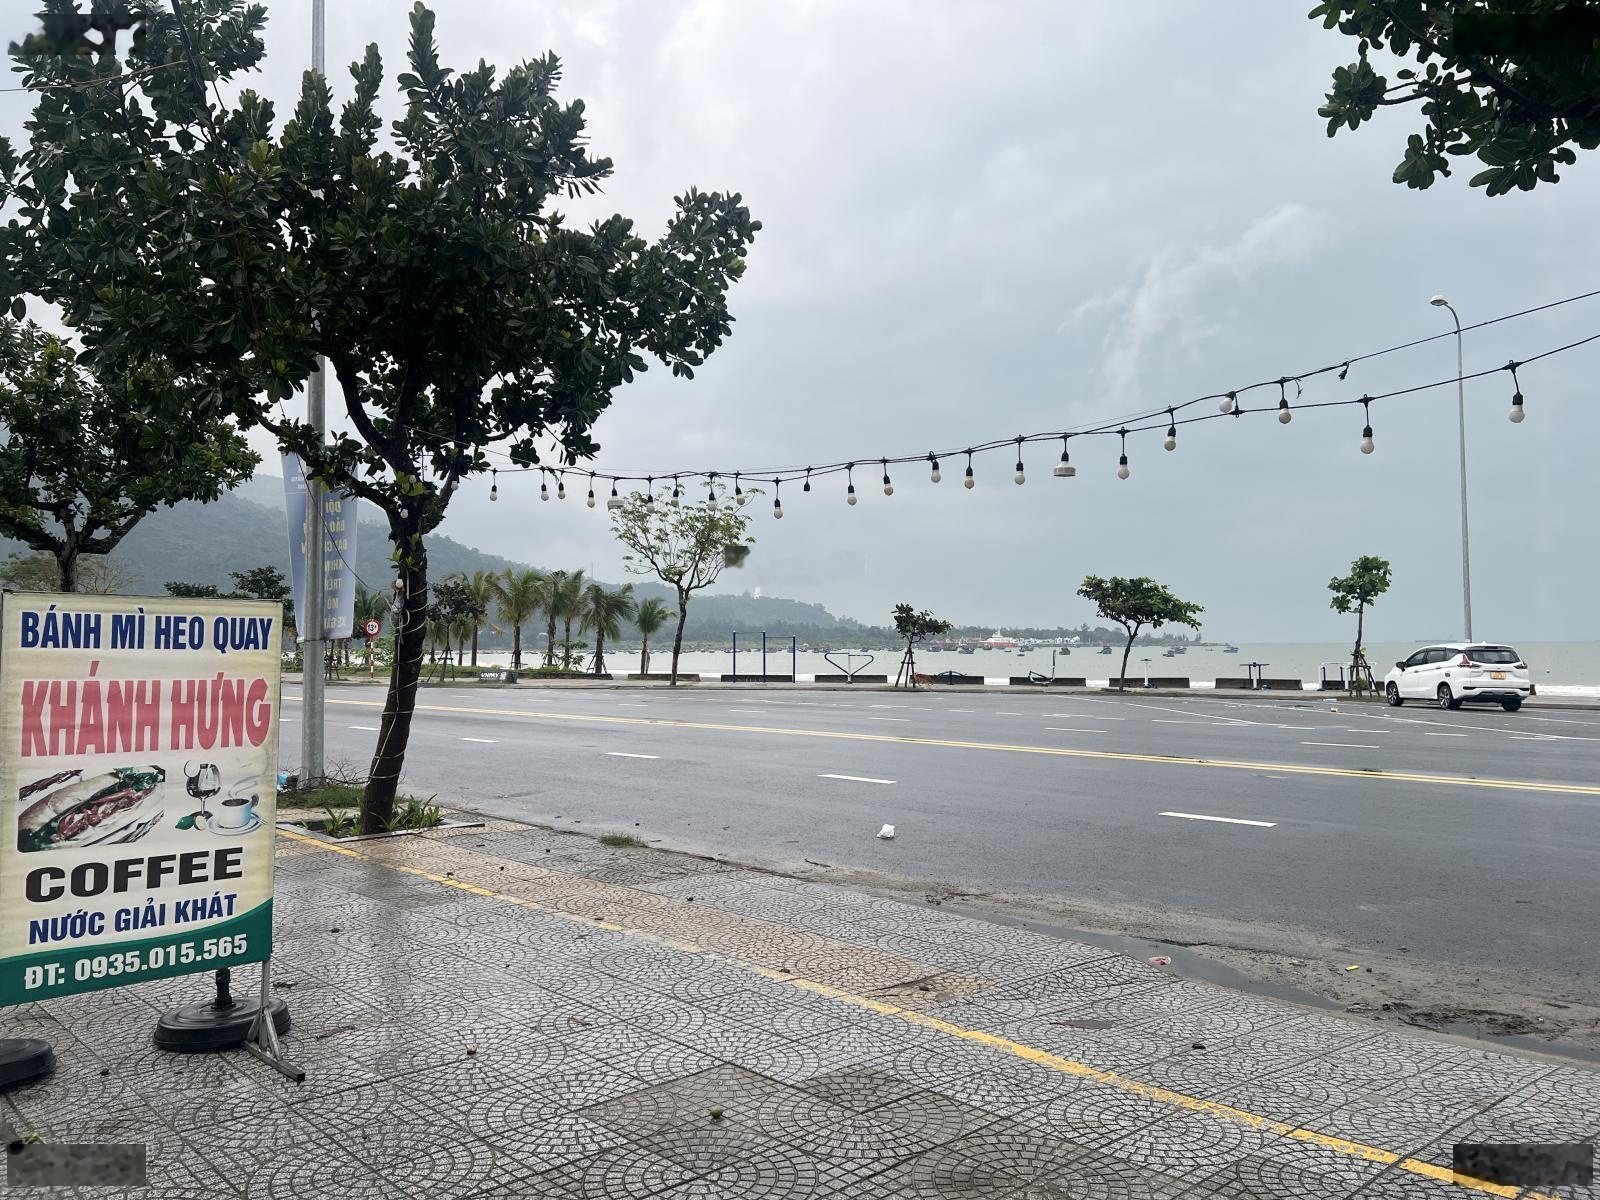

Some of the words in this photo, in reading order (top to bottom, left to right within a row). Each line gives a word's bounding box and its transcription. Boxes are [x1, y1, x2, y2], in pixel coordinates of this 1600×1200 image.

[21, 605, 101, 649] BÁNH
[111, 608, 145, 649] MÌ
[154, 616, 205, 650] HEO
[213, 617, 273, 654] QUAY
[21, 661, 161, 757] KHÁNH
[170, 672, 271, 750] HƯNG
[25, 847, 243, 903] COFFEE
[29, 909, 105, 944] NƯỚC
[114, 897, 166, 932] GIẢI
[174, 891, 237, 924] KHÁT
[24, 962, 65, 990] ĐT:
[74, 933, 248, 981] 0935.015.565
